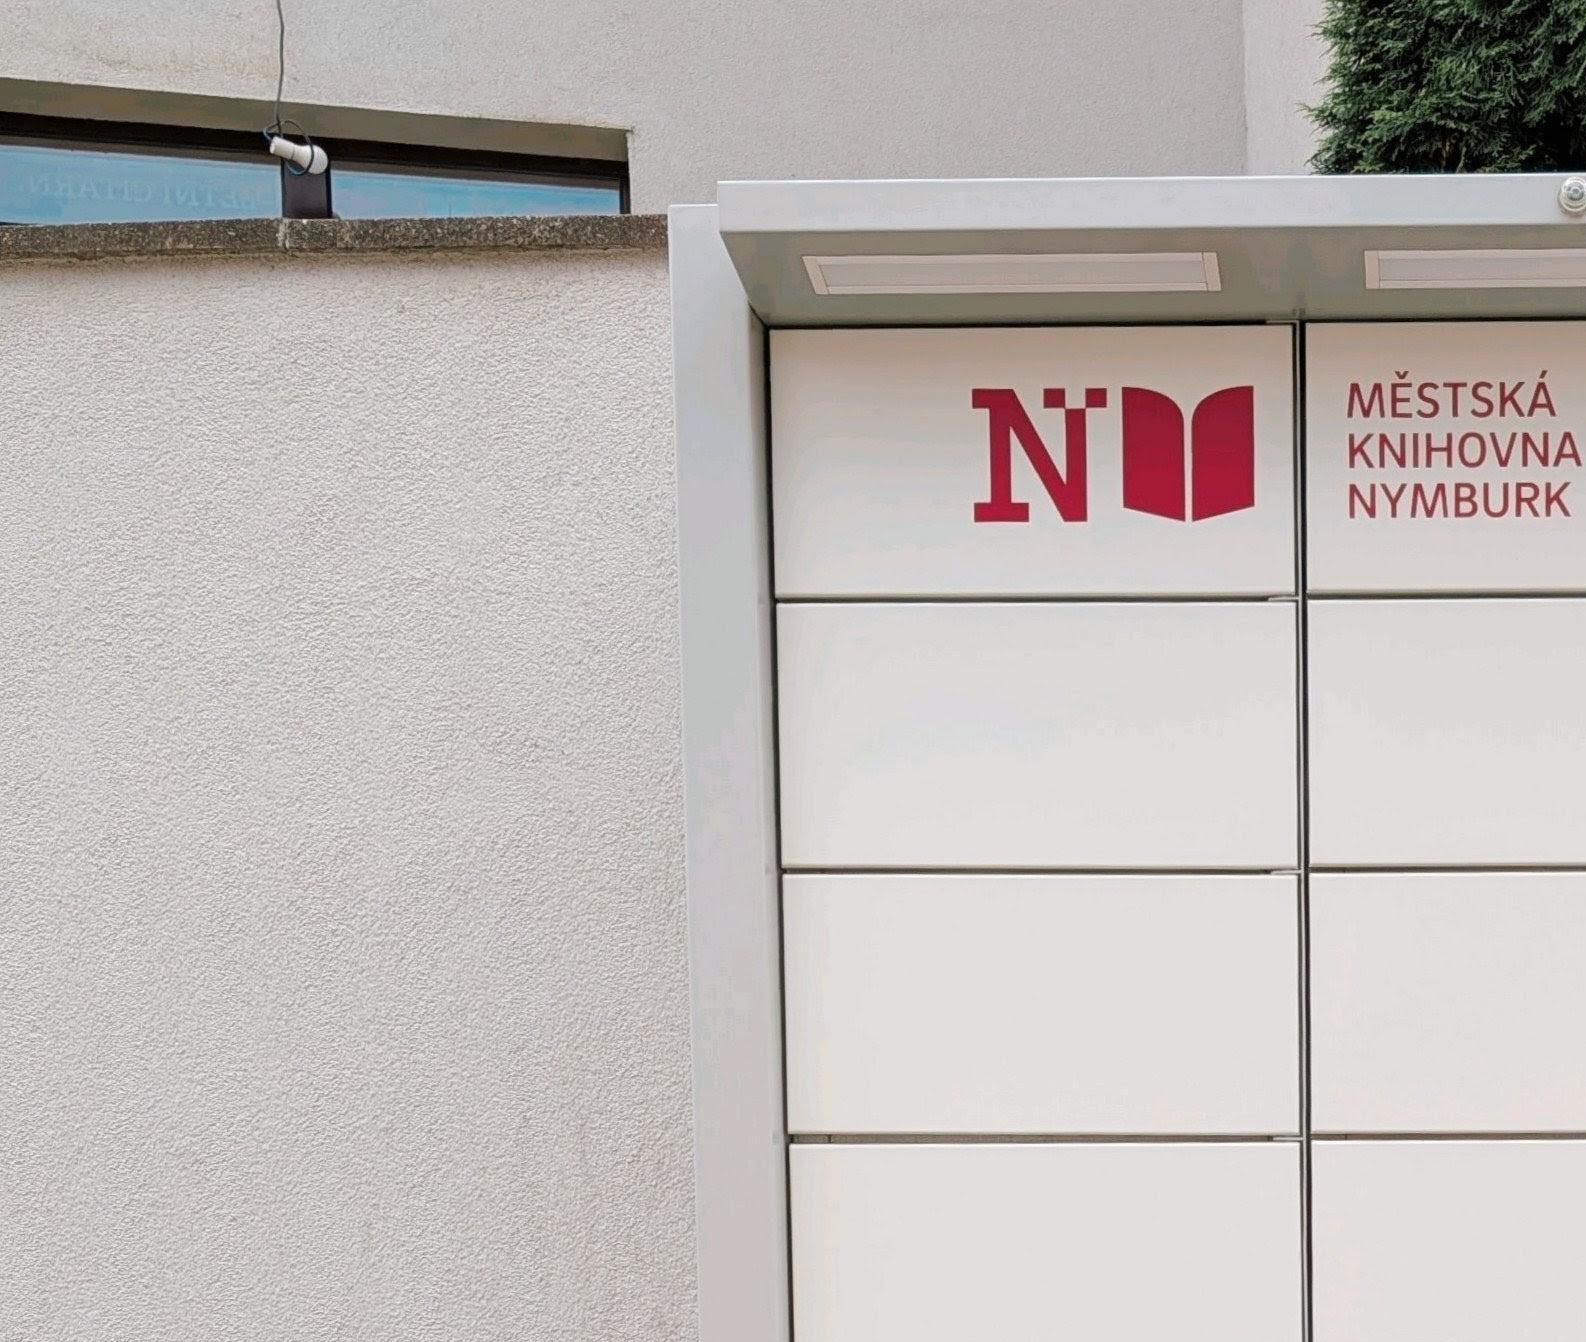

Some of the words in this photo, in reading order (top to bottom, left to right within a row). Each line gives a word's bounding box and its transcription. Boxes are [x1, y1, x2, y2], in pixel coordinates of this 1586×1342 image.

[1346, 369, 1557, 419] MĚSTSKÁ
[1348, 431, 1583, 469] KNIHOVNA
[1348, 481, 1572, 519] NYMBURK
